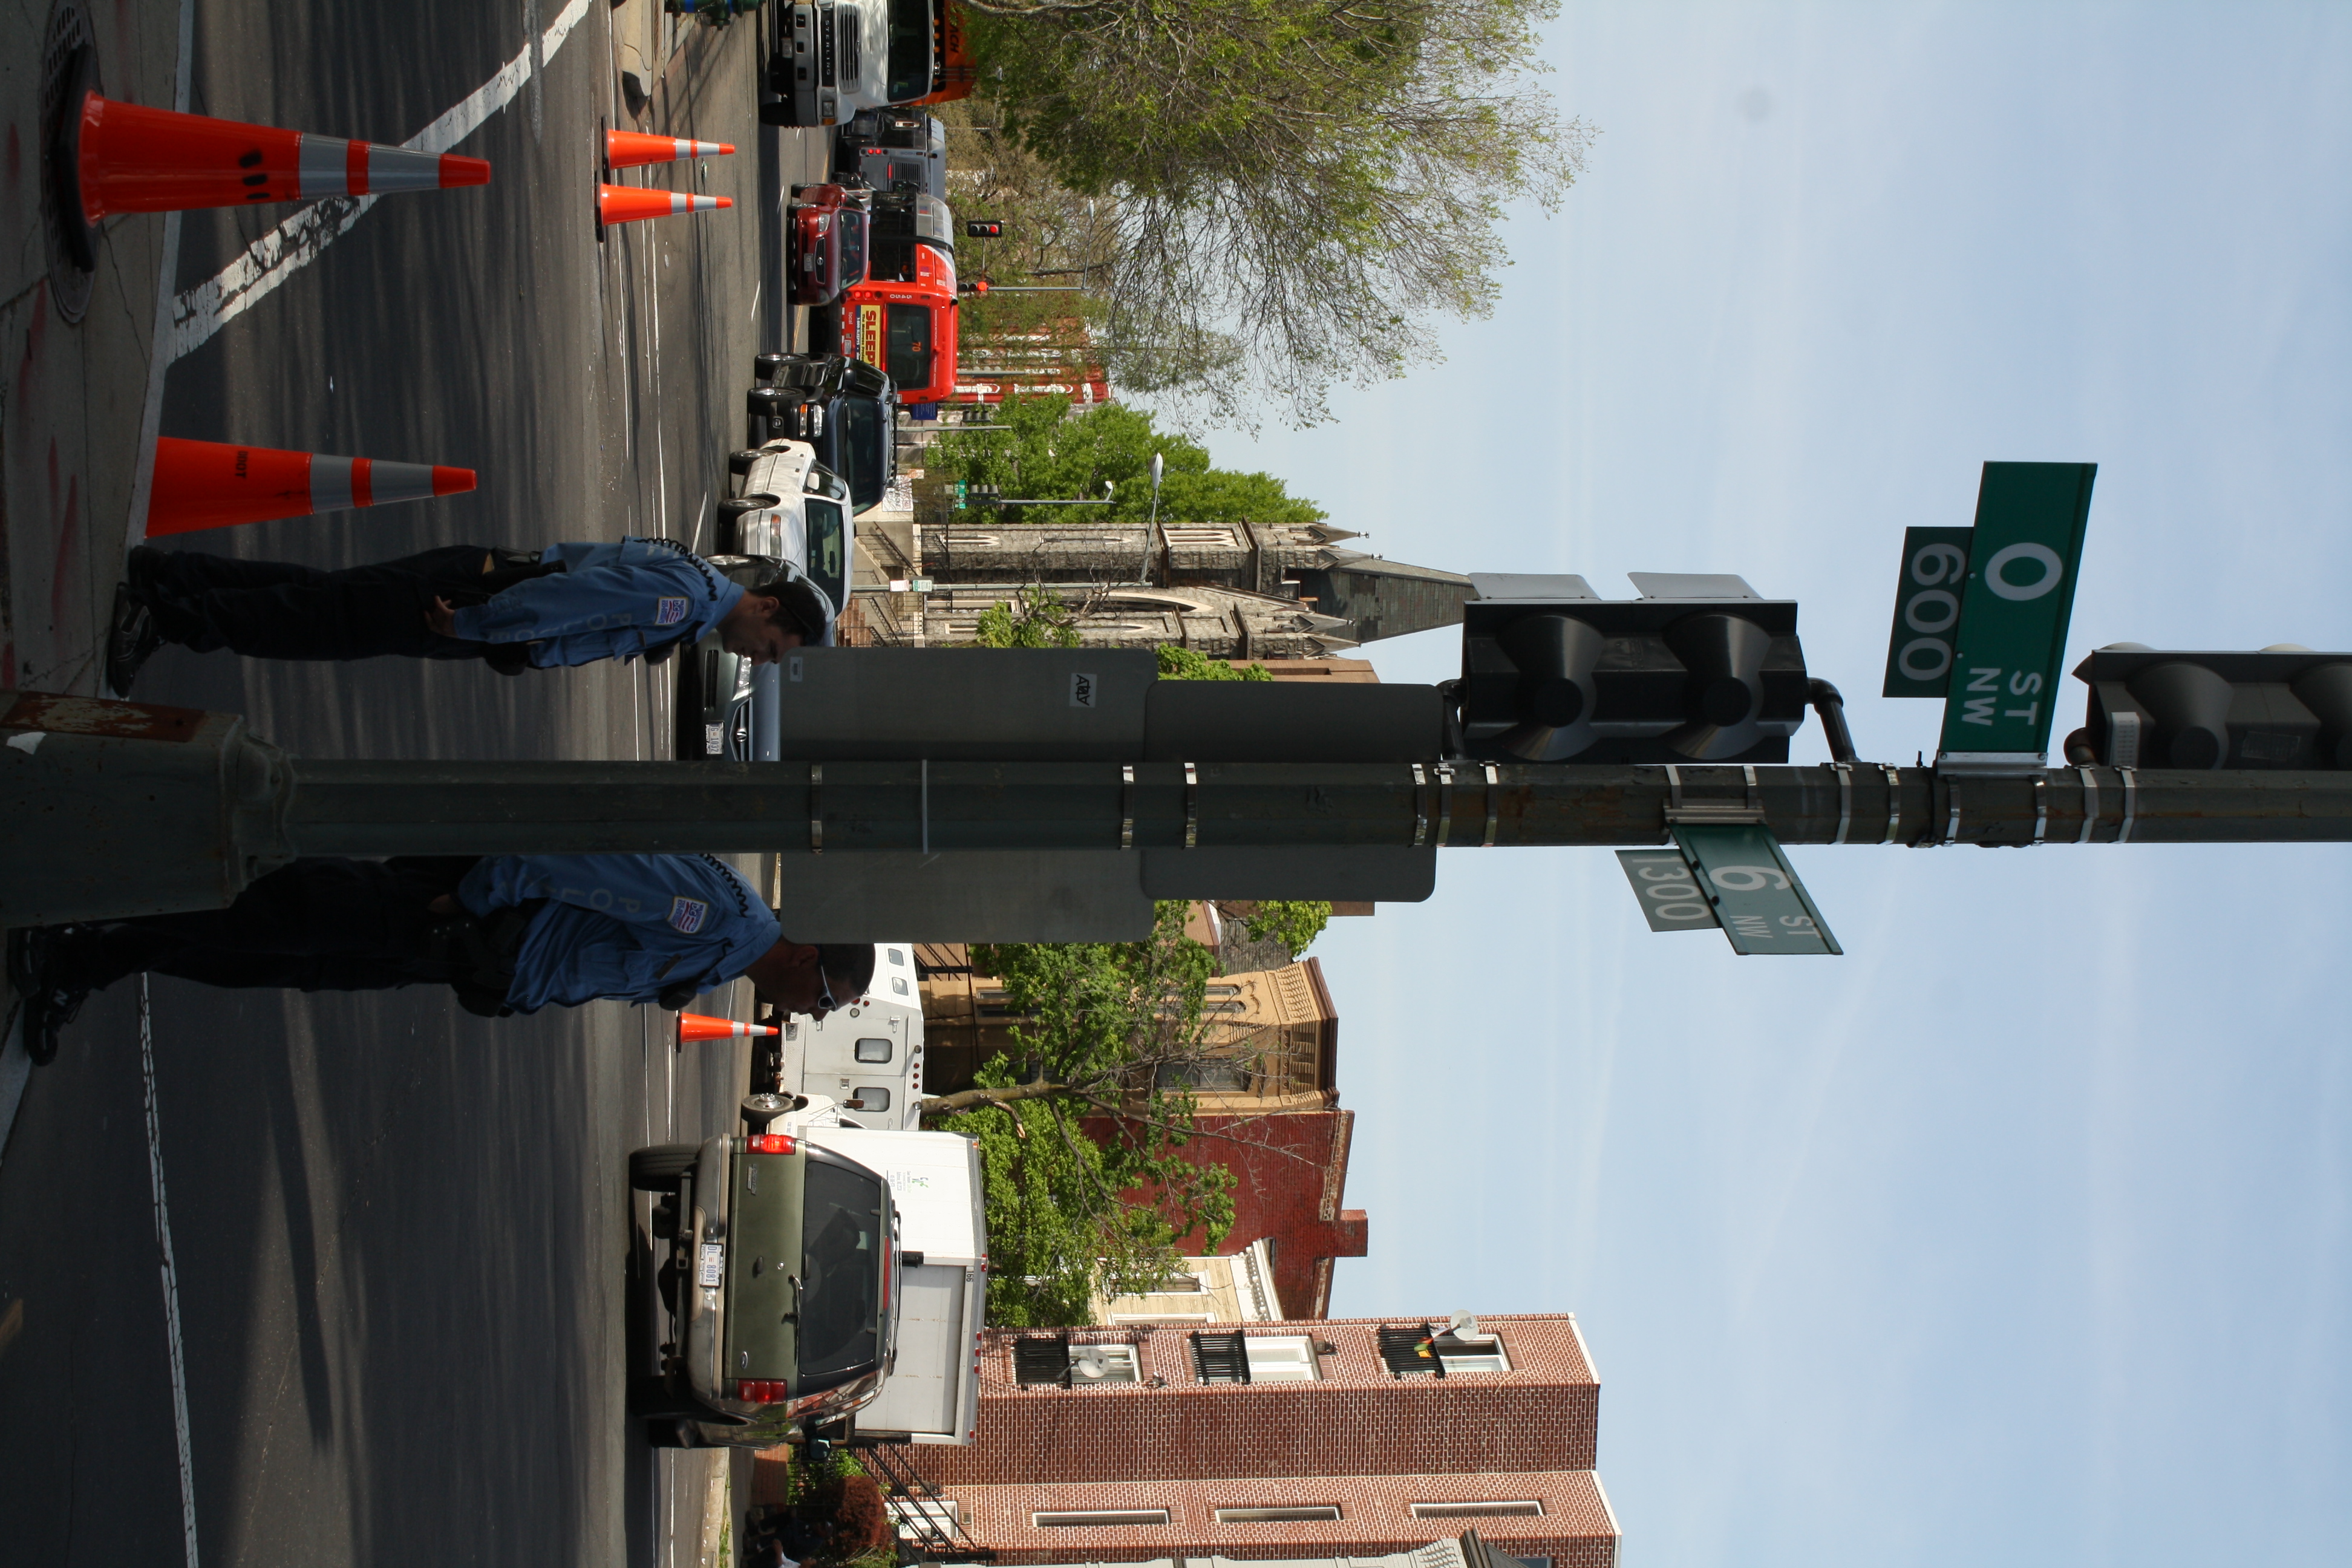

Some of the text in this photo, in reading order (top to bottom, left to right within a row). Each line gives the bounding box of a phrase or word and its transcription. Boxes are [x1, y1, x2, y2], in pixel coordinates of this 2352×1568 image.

[949, 24, 959, 54] ACH
[912, 342, 922, 352] 70
[673, 601, 681, 611] DC
[1898, 543, 1967, 681] 600
[489, 613, 632, 642] POLICE
[1984, 543, 2063, 726] O ST
[1961, 667, 2002, 727] NW
[1632, 856, 1711, 921] 1300
[1708, 865, 1822, 938] 6 ST
[690, 904, 699, 916] DC
[1729, 915, 1773, 938] NW
[706, 1246, 717, 1282] DL 8081
